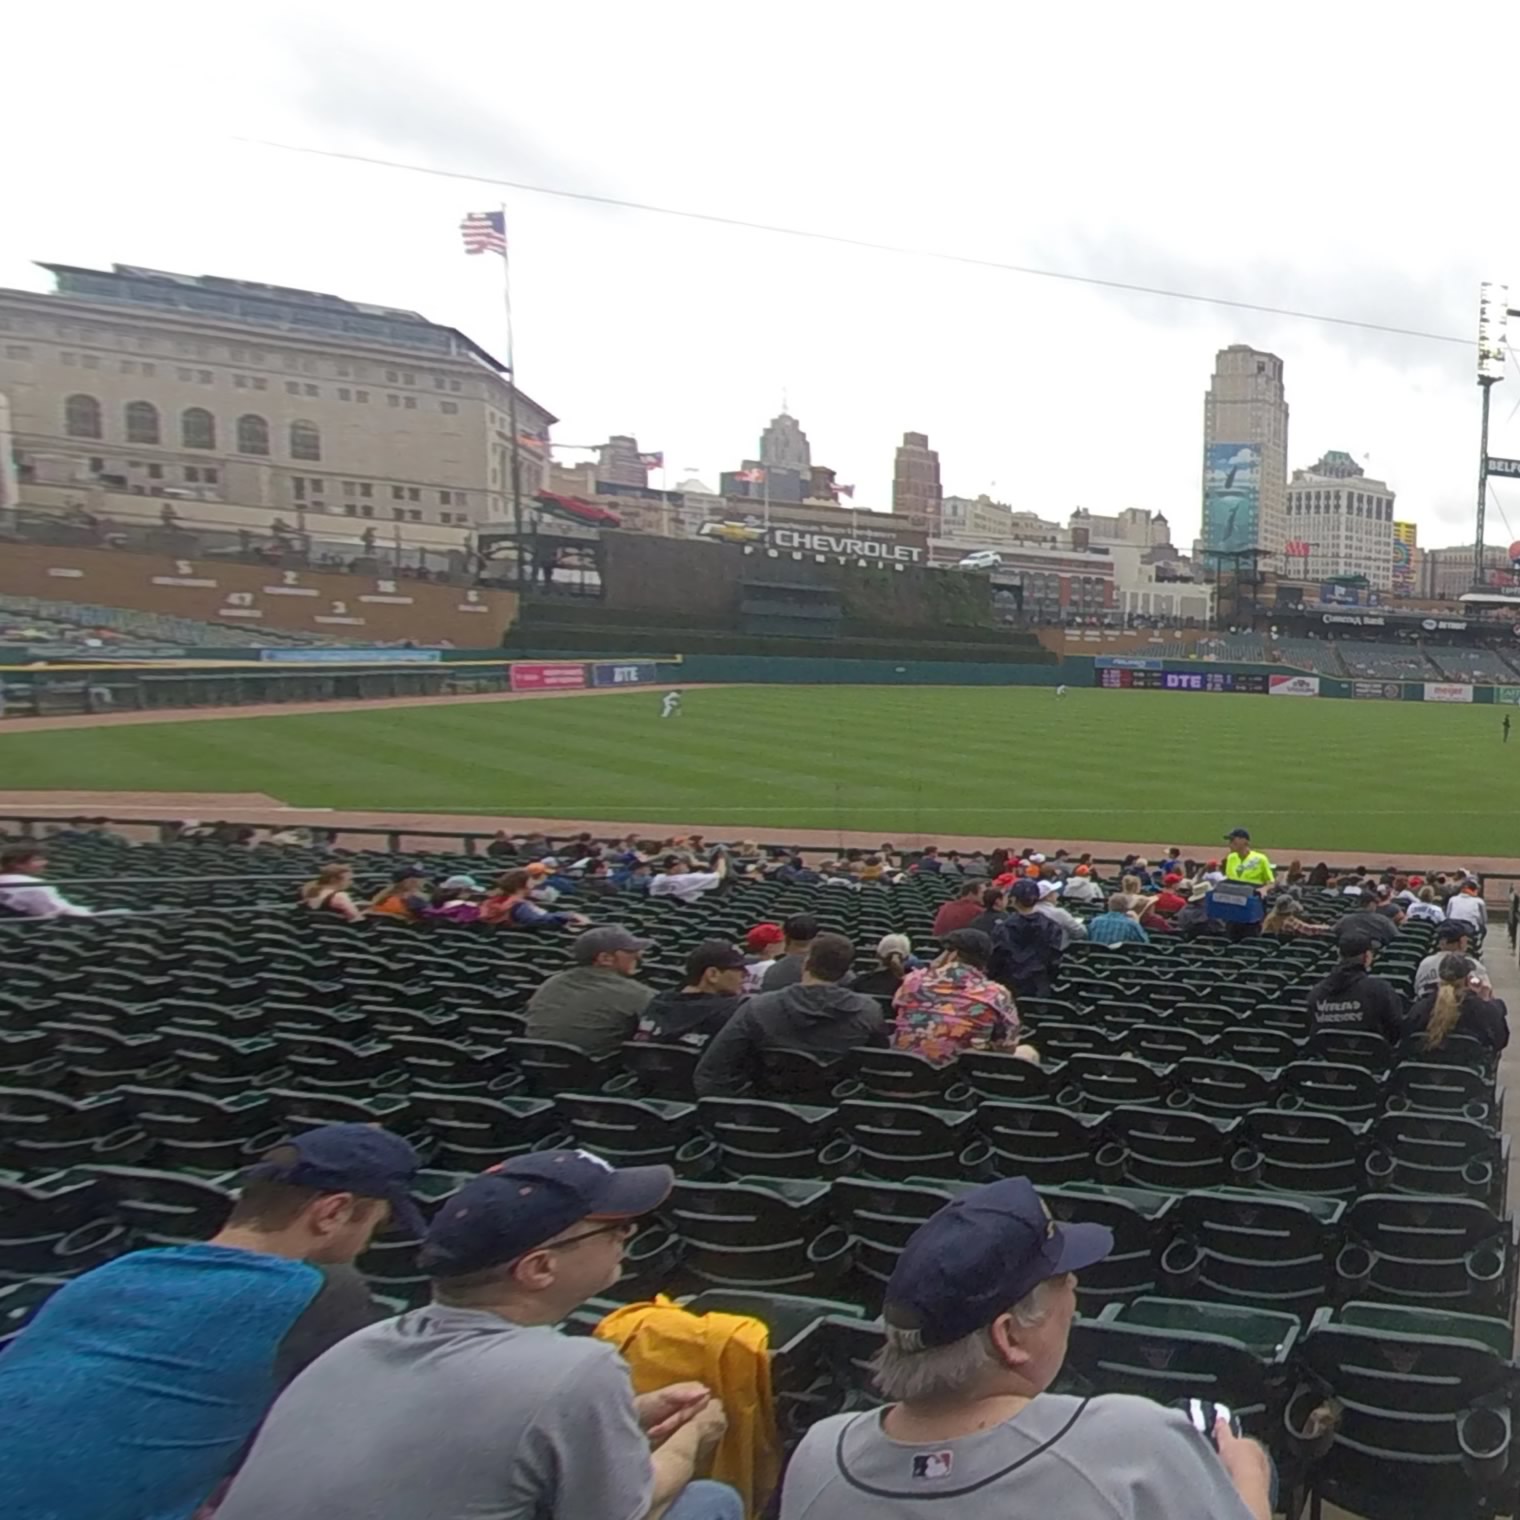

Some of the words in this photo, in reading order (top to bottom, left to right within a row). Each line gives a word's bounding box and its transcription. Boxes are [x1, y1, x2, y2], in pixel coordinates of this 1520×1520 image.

[775, 529, 923, 562] CHEVROLET
[743, 545, 905, 571] FOUNTAIN
[613, 666, 639, 683] DTE
[1166, 673, 1203, 689] DTE
